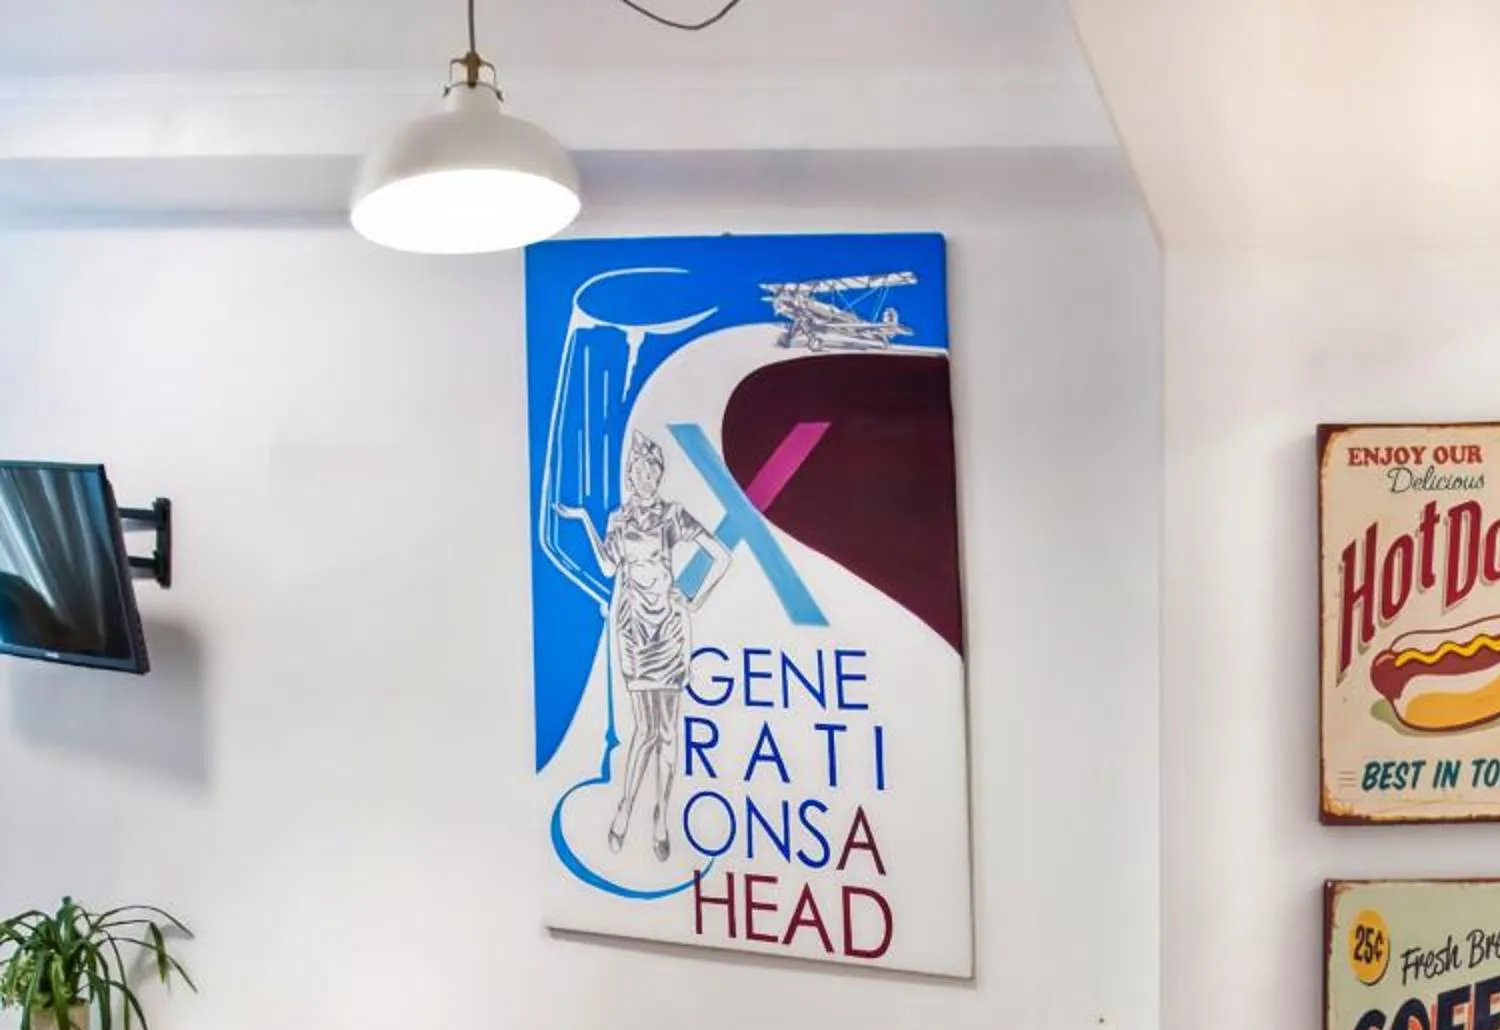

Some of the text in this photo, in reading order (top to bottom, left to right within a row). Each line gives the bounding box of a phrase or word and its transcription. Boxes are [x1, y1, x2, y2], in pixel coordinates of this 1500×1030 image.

[1347, 444, 1482, 467] ENJOY OUR
[1387, 465, 1485, 494] Delicious
[685, 647, 869, 710] GENE
[1361, 759, 1424, 791] BEST
[1432, 760, 1461, 789] IN
[692, 869, 893, 960] HEAD
[1400, 935, 1462, 986] Fresh
